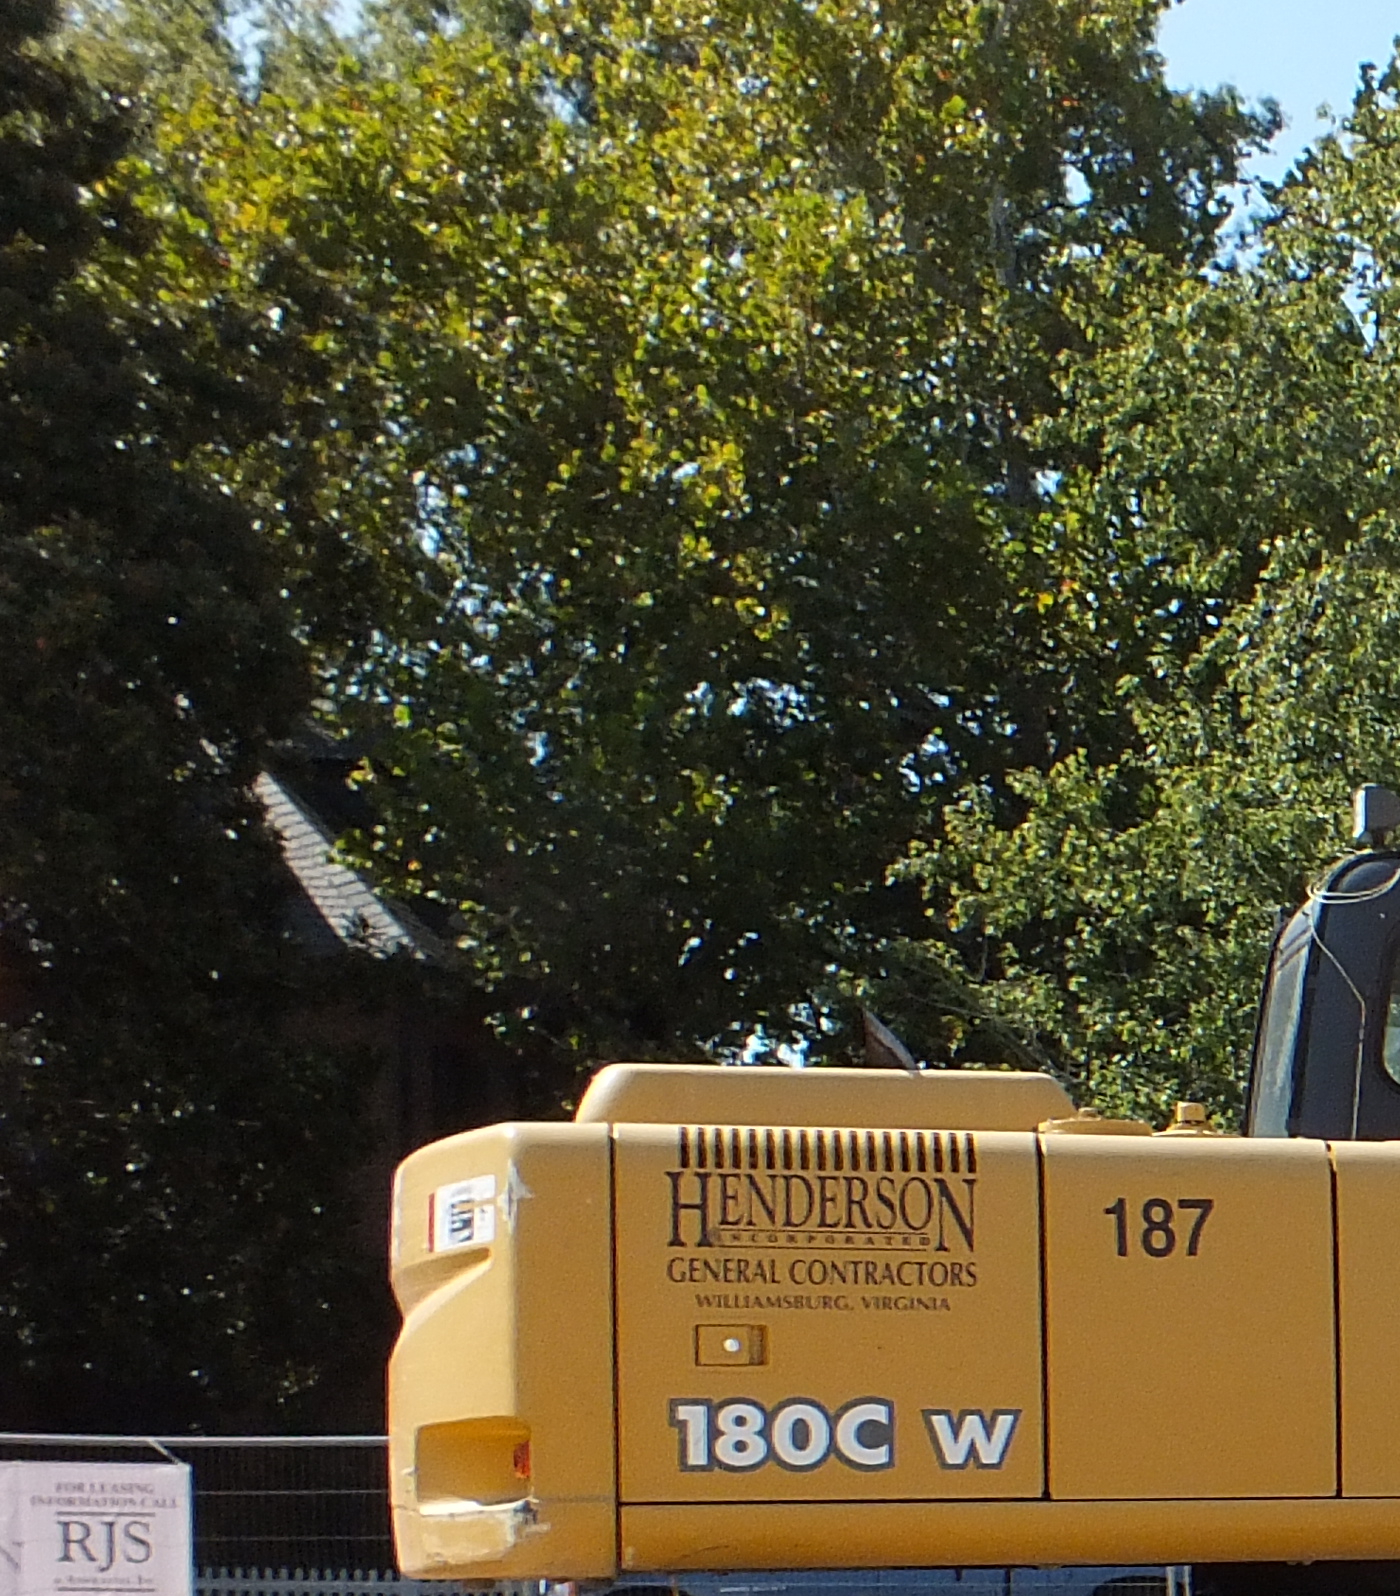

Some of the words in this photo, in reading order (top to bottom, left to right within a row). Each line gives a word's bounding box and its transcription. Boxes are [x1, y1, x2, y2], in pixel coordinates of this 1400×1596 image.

[665, 1171, 977, 1252] HENDERSON
[1104, 1198, 1214, 1257] 187
[666, 1256, 780, 1284] GENERAL
[788, 1259, 977, 1287] CONTRACTORS
[861, 1296, 951, 1311] VIRGINIA
[674, 1401, 892, 1468] 180C
[56, 1520, 153, 1573] RJS
